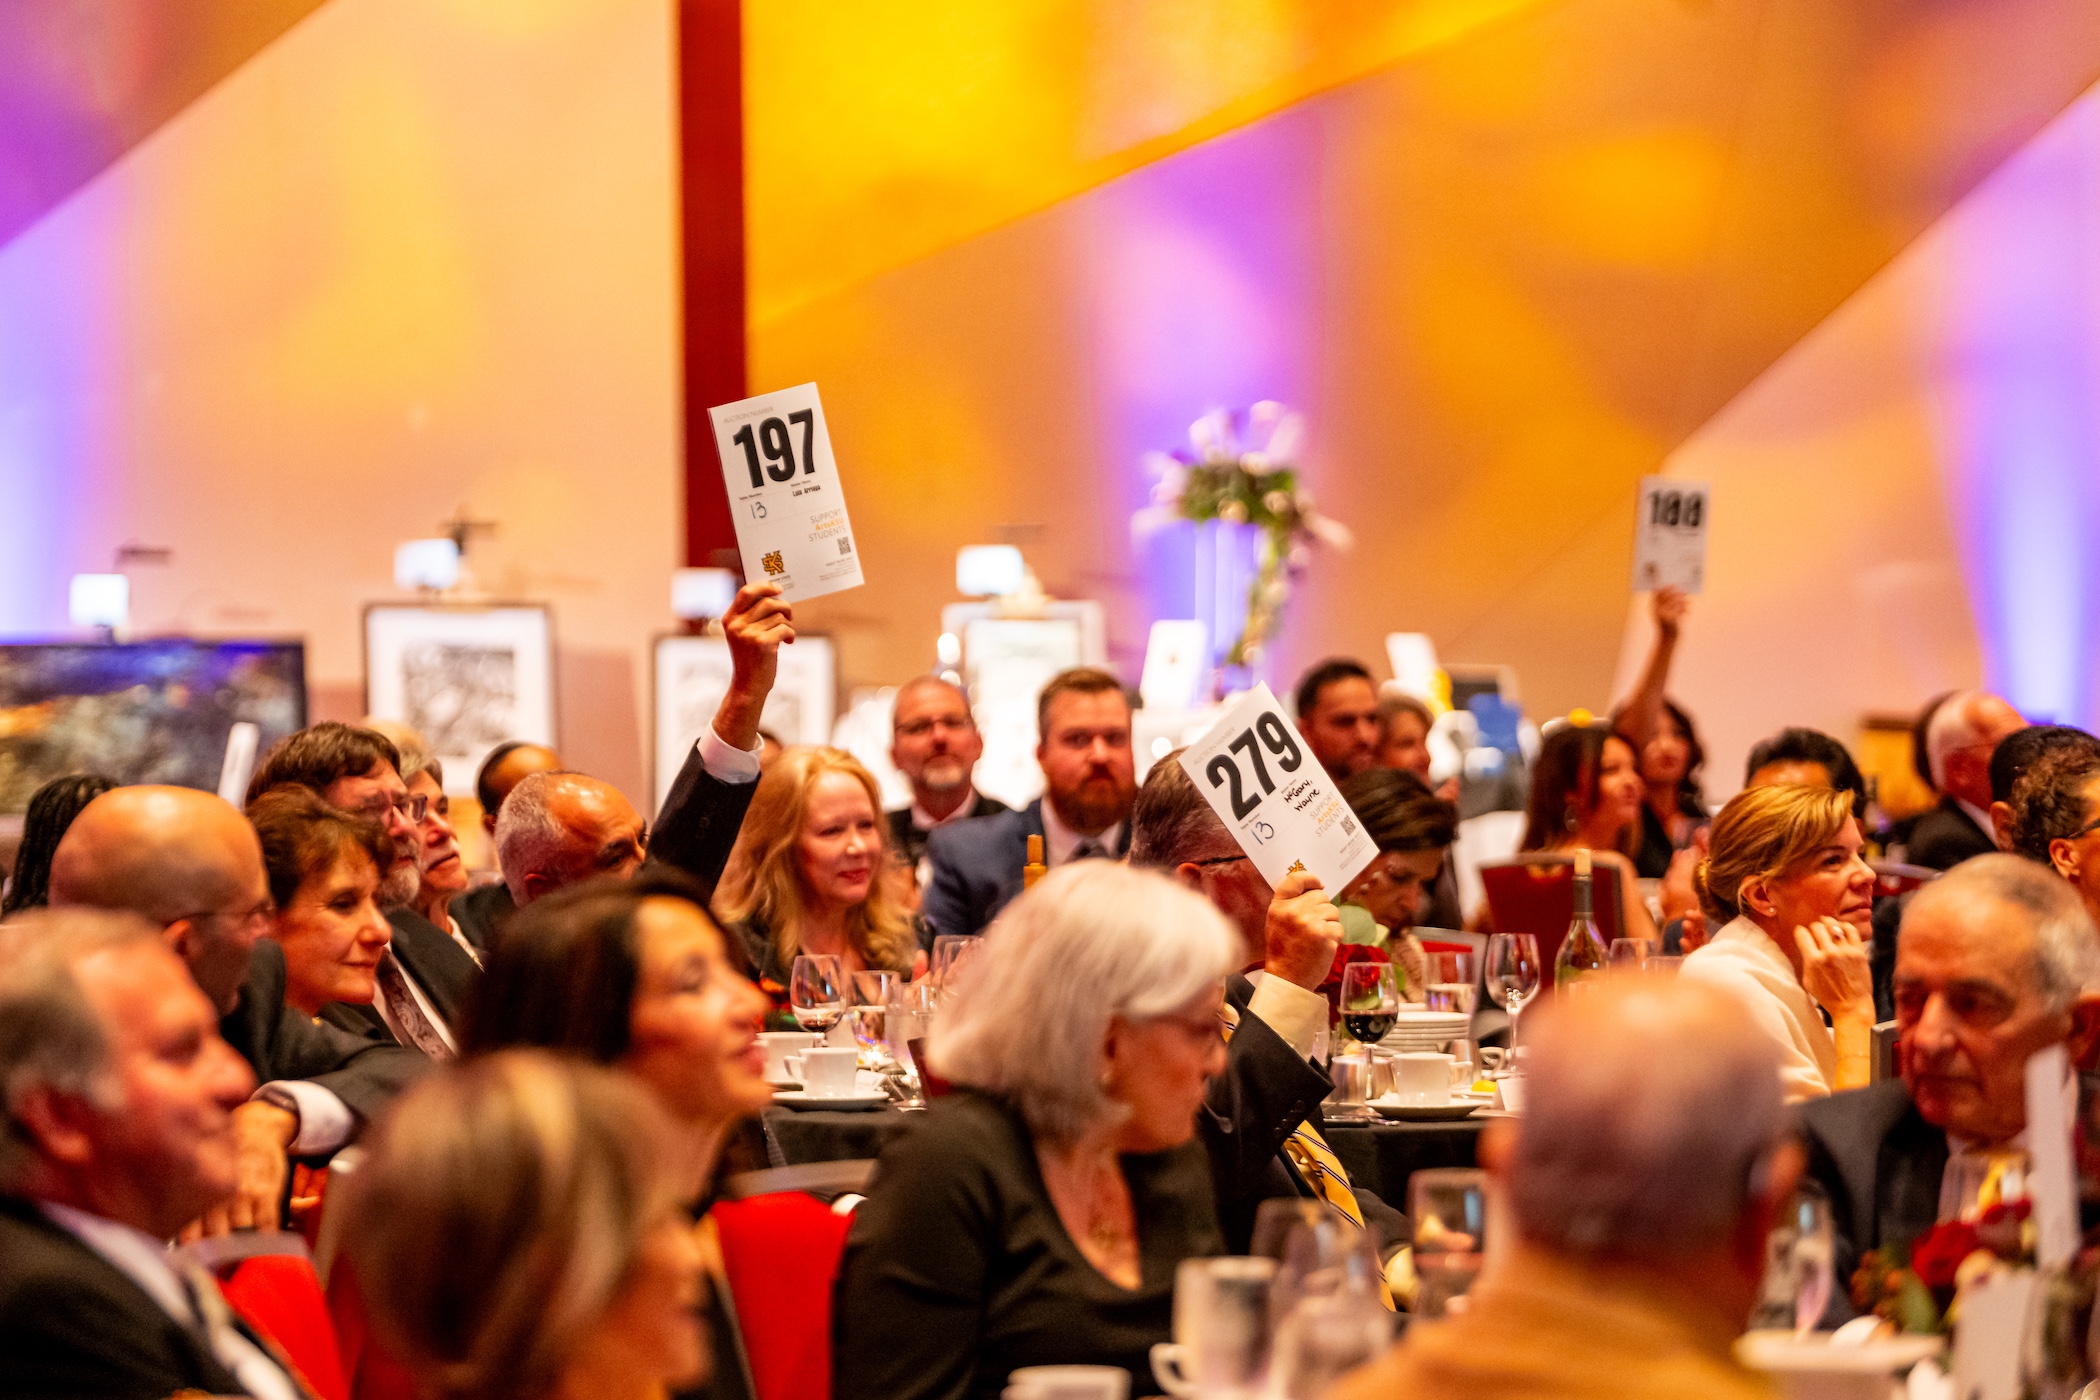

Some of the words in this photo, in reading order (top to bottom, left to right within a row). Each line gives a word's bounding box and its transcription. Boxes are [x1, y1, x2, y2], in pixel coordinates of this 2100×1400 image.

[732, 407, 816, 489] 197
[750, 500, 767, 520] 13
[810, 508, 842, 524] SUPPORT
[808, 526, 846, 542] STUDENTS
[815, 516, 844, 531] ArtsKSU
[1205, 710, 1302, 822] 279
[1294, 788, 1320, 812] Wayne
[1310, 792, 1335, 819] SUPPORT
[1317, 799, 1340, 824] ArtsKSU
[1250, 821, 1275, 846] 13
[1315, 806, 1346, 838] STUDENTS
